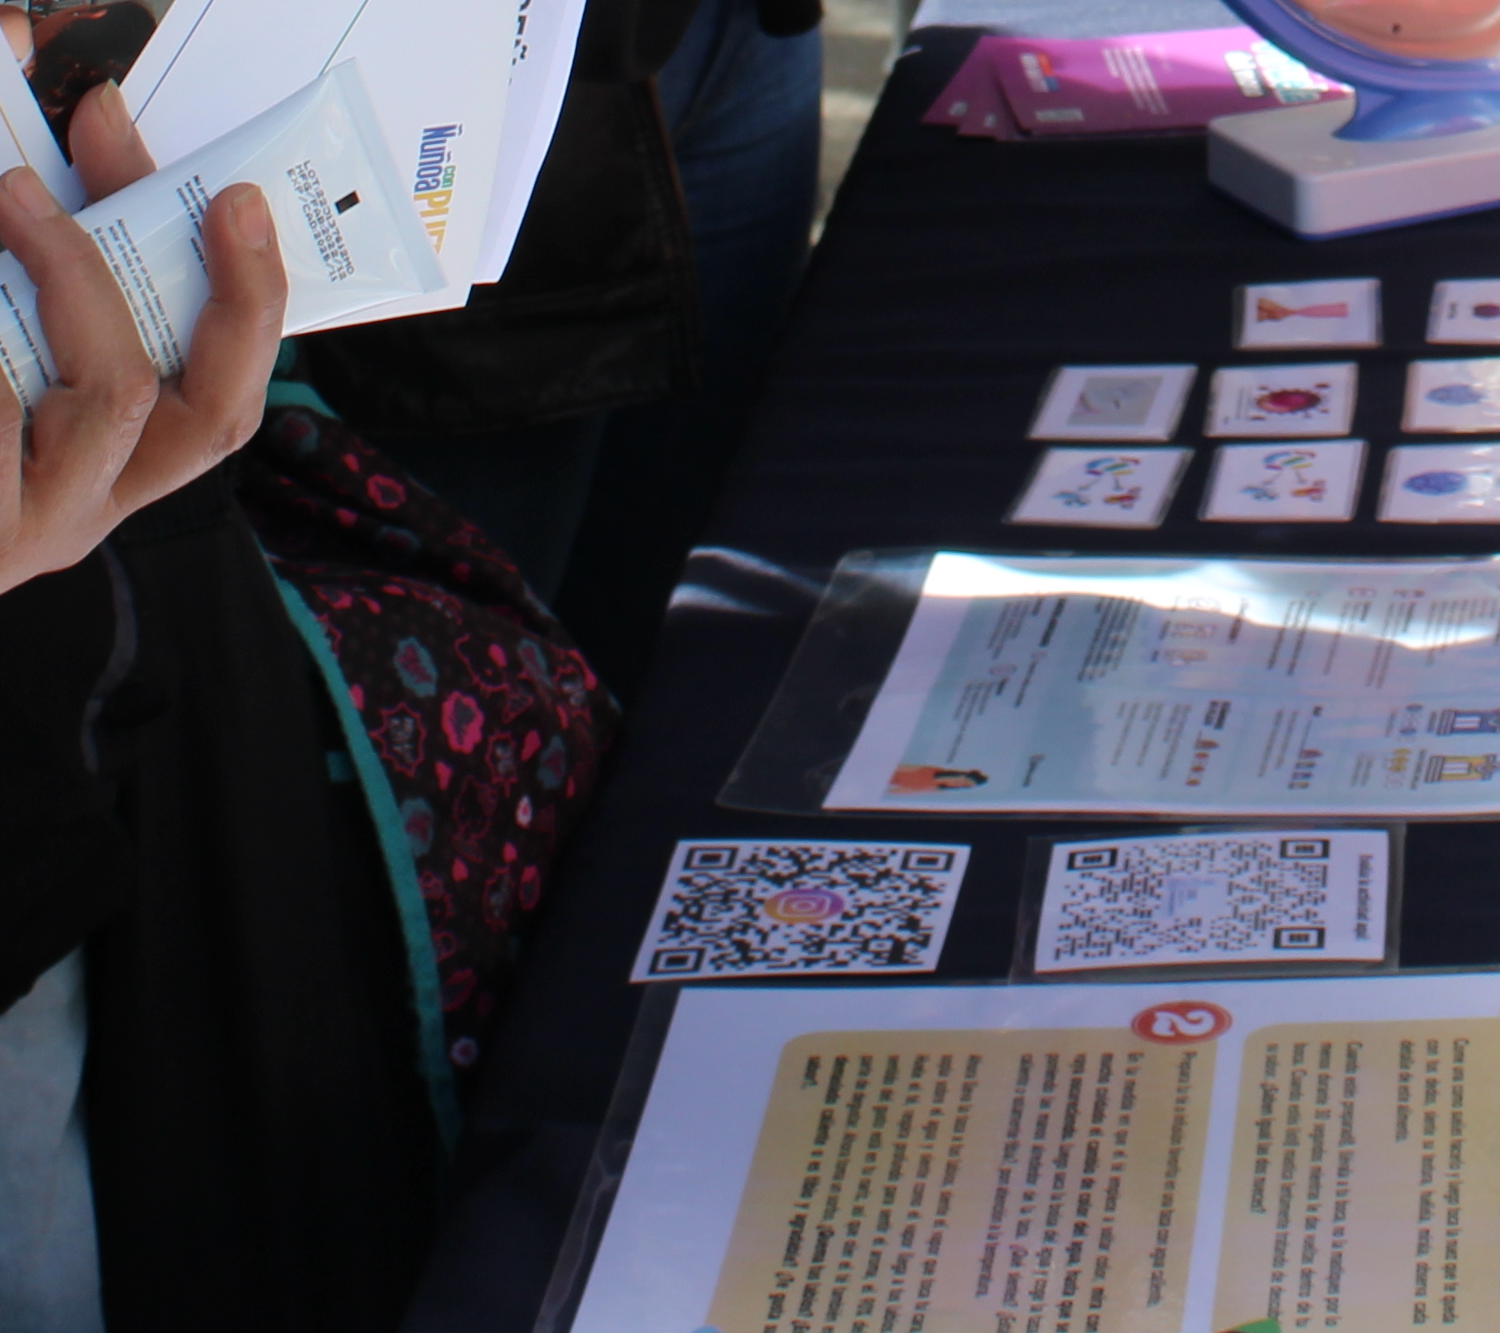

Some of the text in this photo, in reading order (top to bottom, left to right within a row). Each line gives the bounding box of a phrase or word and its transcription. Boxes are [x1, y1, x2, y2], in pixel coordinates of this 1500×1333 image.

[414, 124, 463, 193] Ñuñoa
[442, 166, 456, 188] con
[141, 275, 158, 296] lugar
[136, 287, 164, 331] temperatura
[1152, 1009, 1217, 1037] 2
